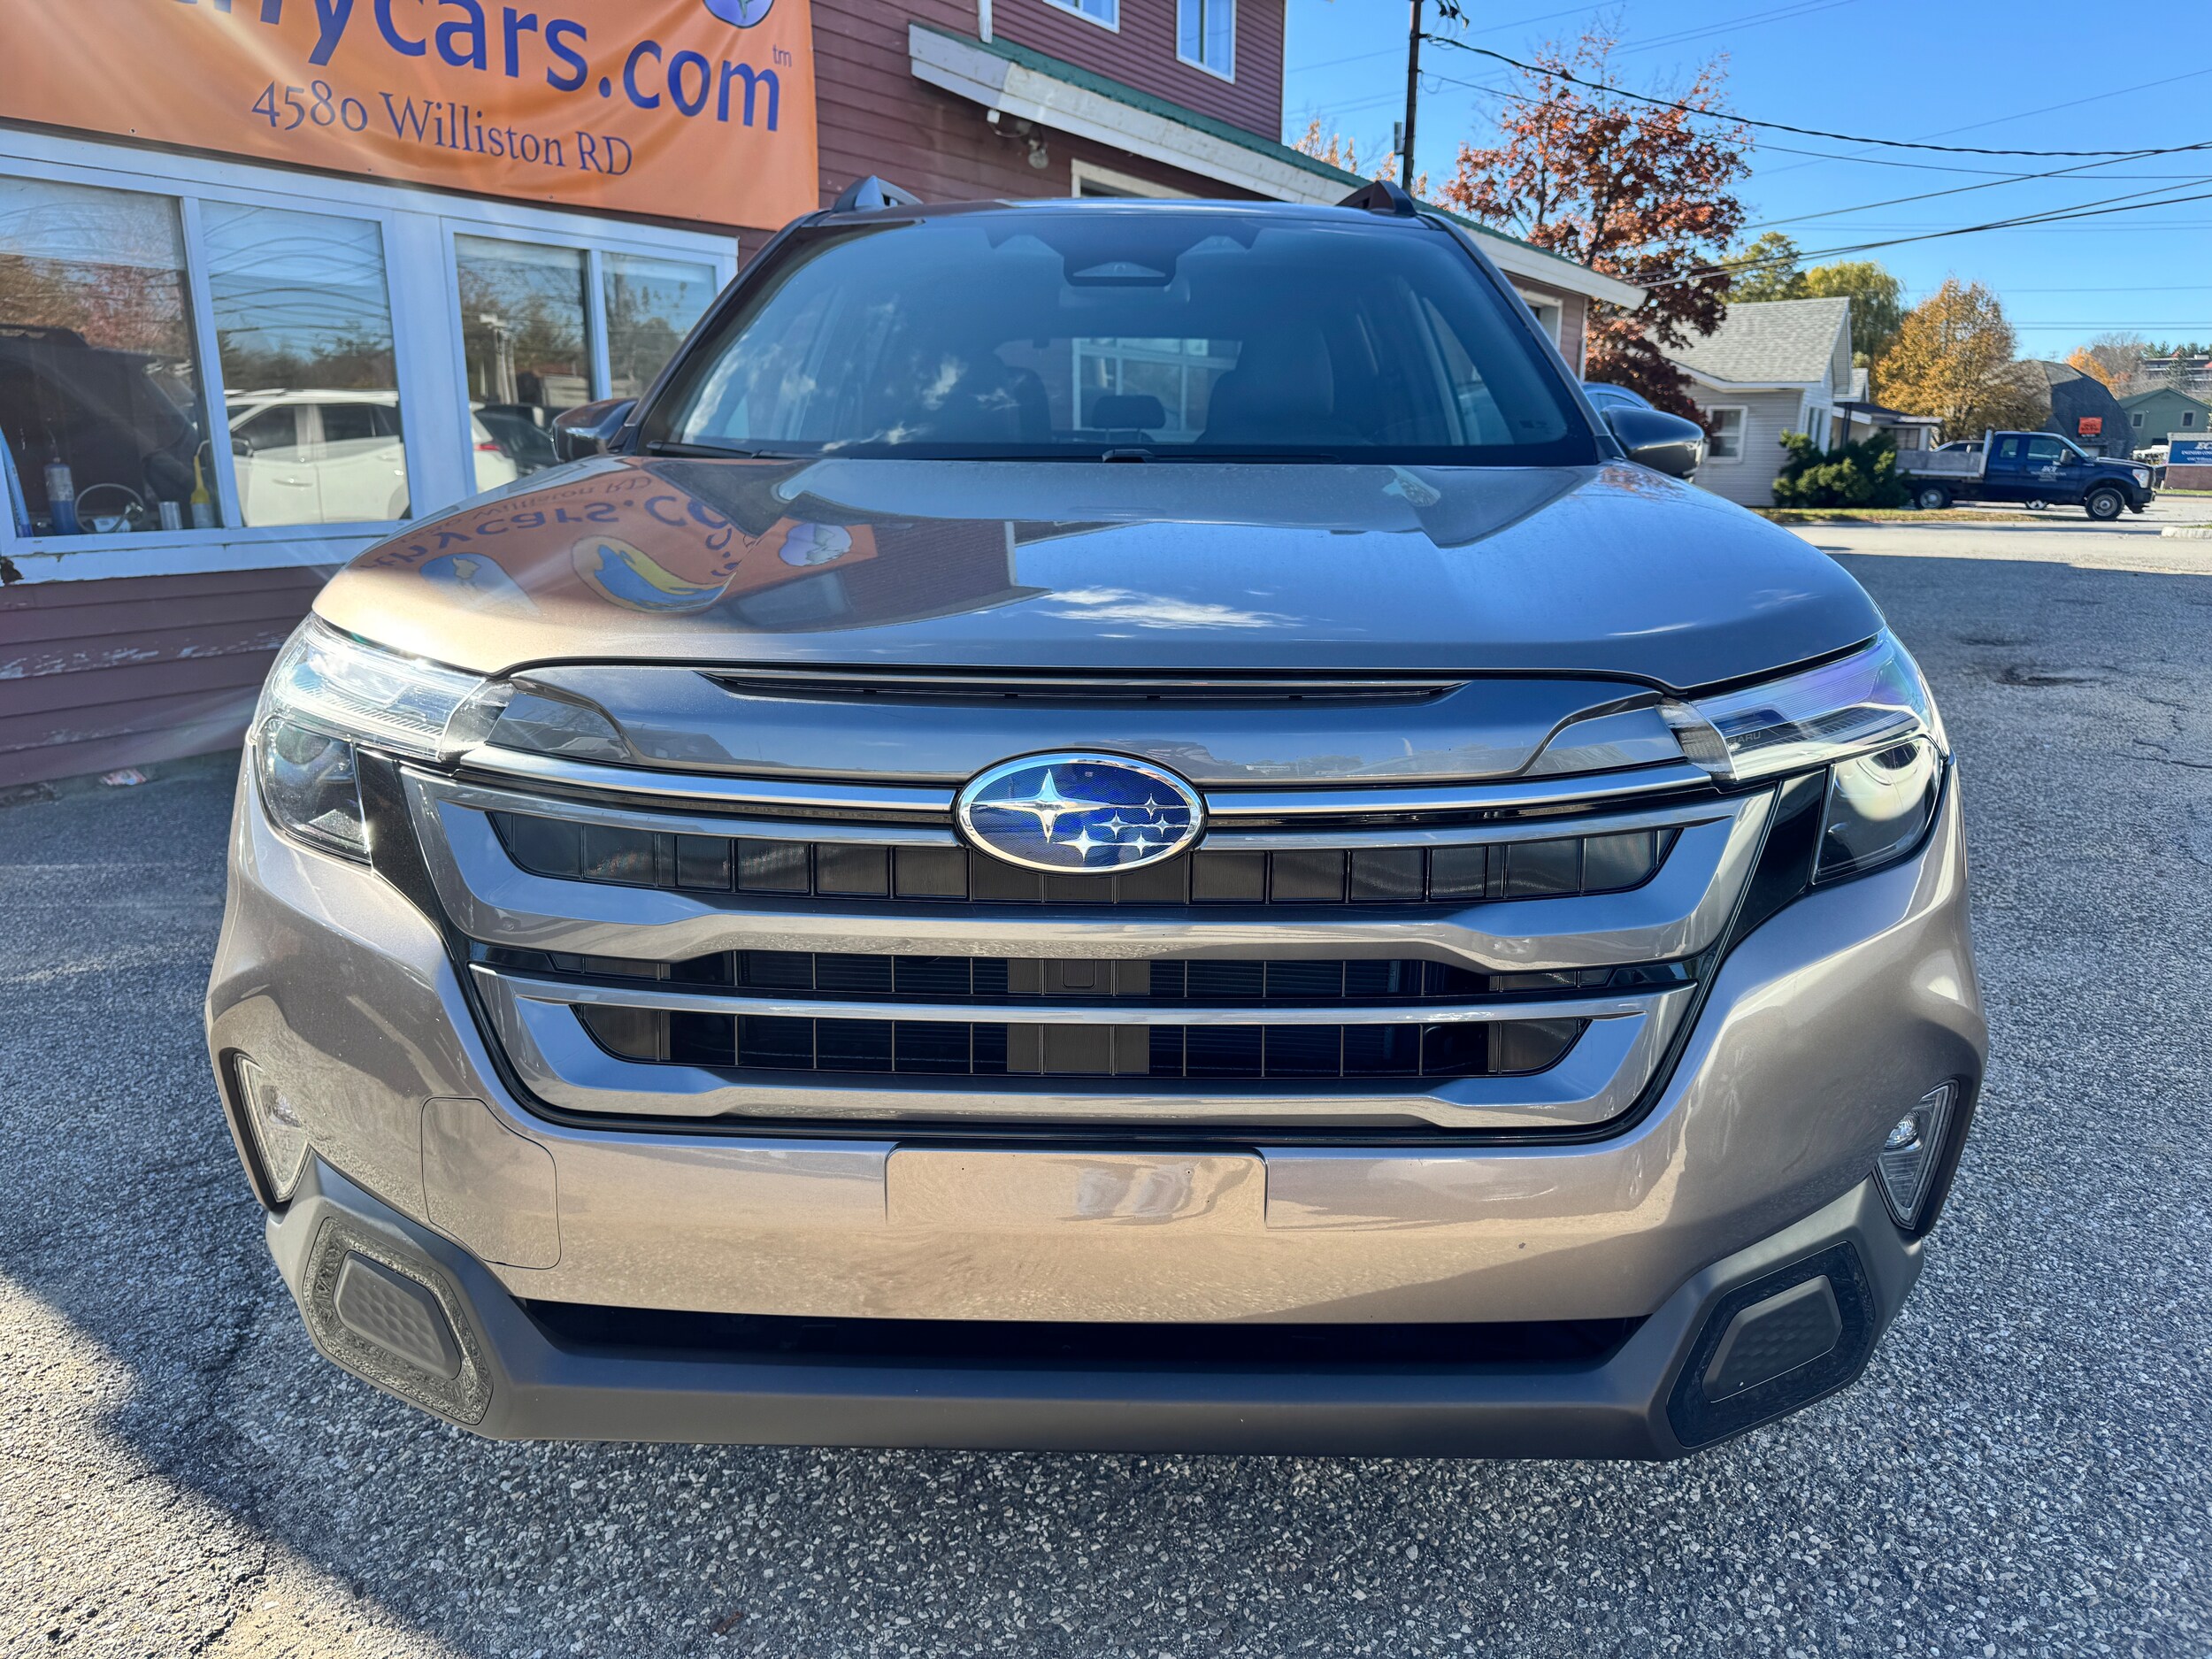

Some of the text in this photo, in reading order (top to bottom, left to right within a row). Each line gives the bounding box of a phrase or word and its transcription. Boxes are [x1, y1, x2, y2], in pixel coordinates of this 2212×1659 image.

[251, 80, 633, 175] 4580 Williston RD
